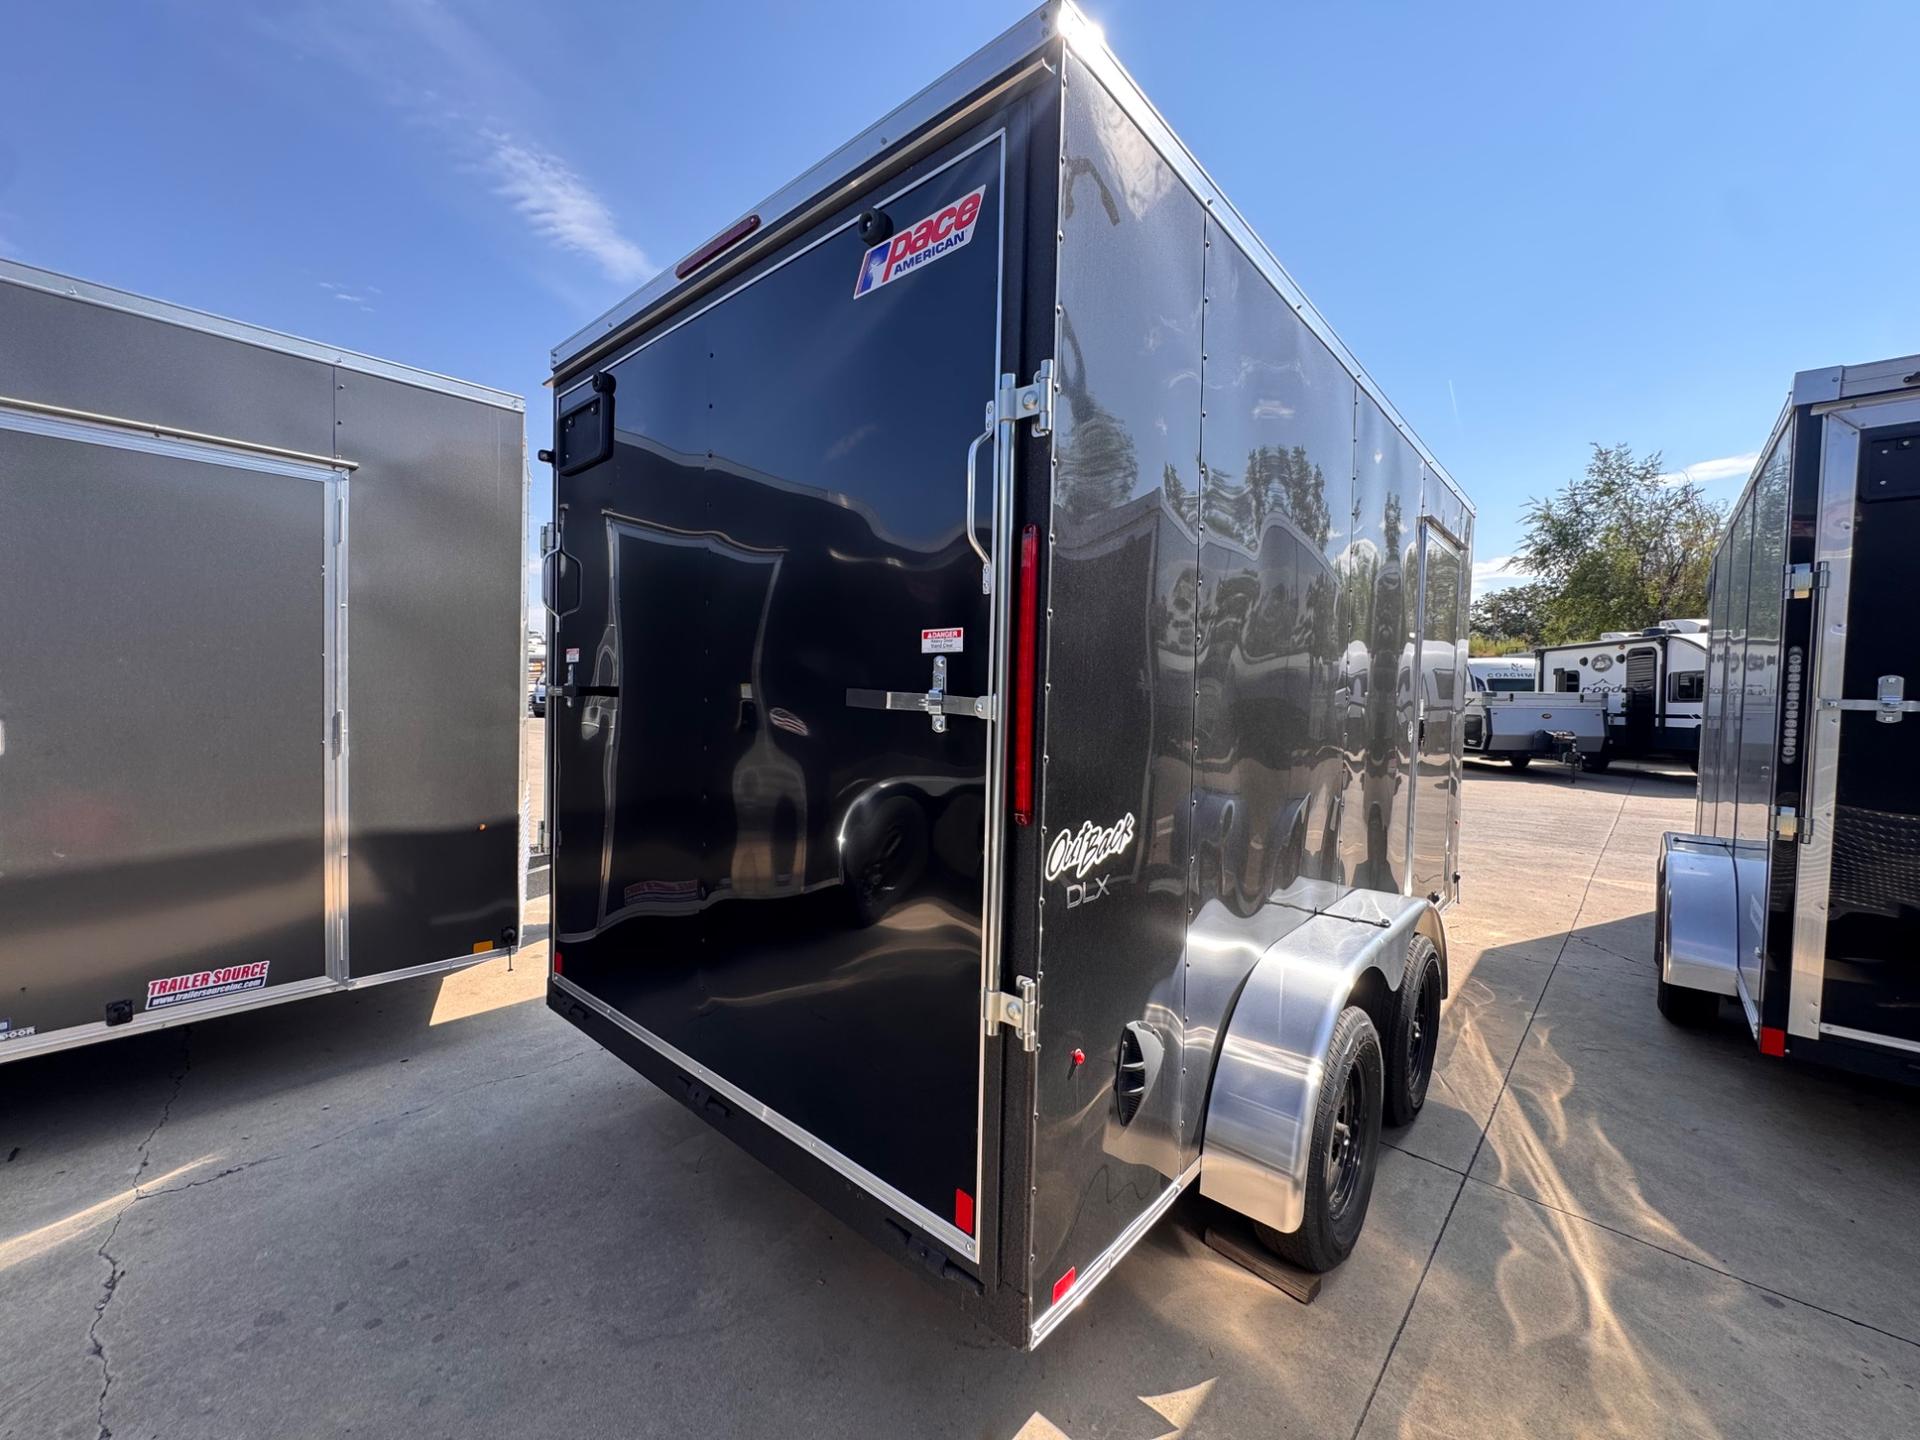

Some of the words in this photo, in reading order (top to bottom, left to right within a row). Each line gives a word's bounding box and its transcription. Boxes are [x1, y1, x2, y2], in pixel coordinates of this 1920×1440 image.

[881, 192, 982, 284] pace
[893, 230, 966, 276] AMERICAN
[932, 630, 958, 638] DANGER
[1066, 874, 1110, 909] DLX
[150, 972, 211, 996] TRAILER
[213, 962, 268, 984] SOURCE
[152, 979, 262, 1006] www.trailersourceinc.com
